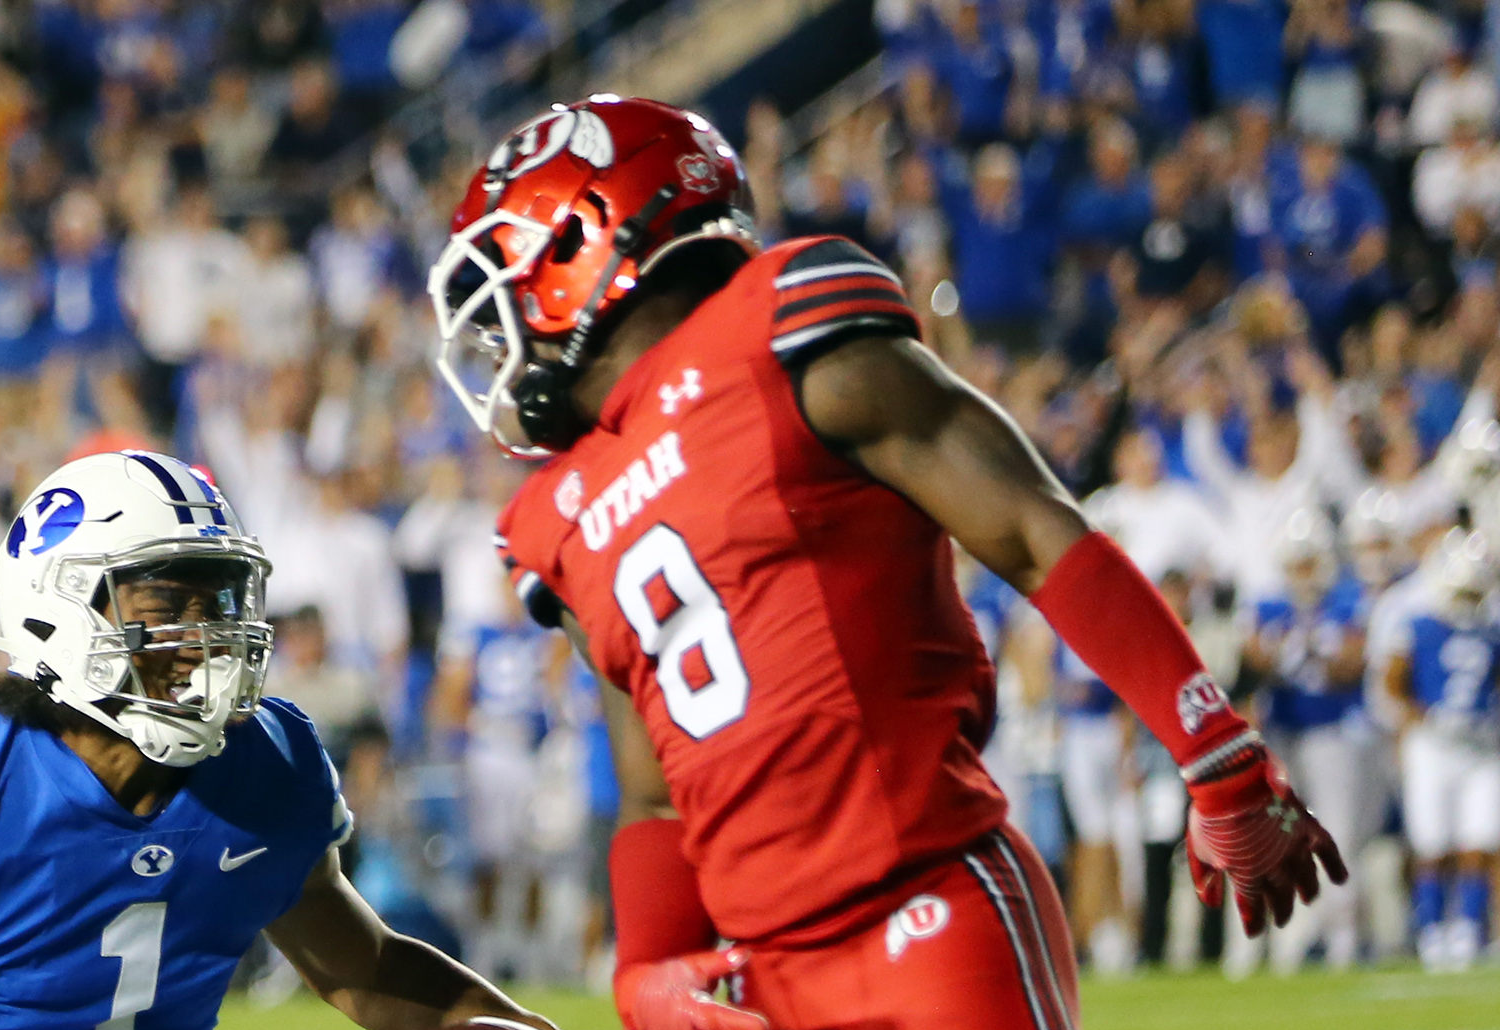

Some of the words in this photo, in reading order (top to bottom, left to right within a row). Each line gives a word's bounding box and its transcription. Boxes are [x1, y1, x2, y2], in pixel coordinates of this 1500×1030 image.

[16, 490, 74, 551] Y
[577, 431, 687, 552] UTAH
[613, 521, 751, 741] 8
[137, 849, 169, 874] Y
